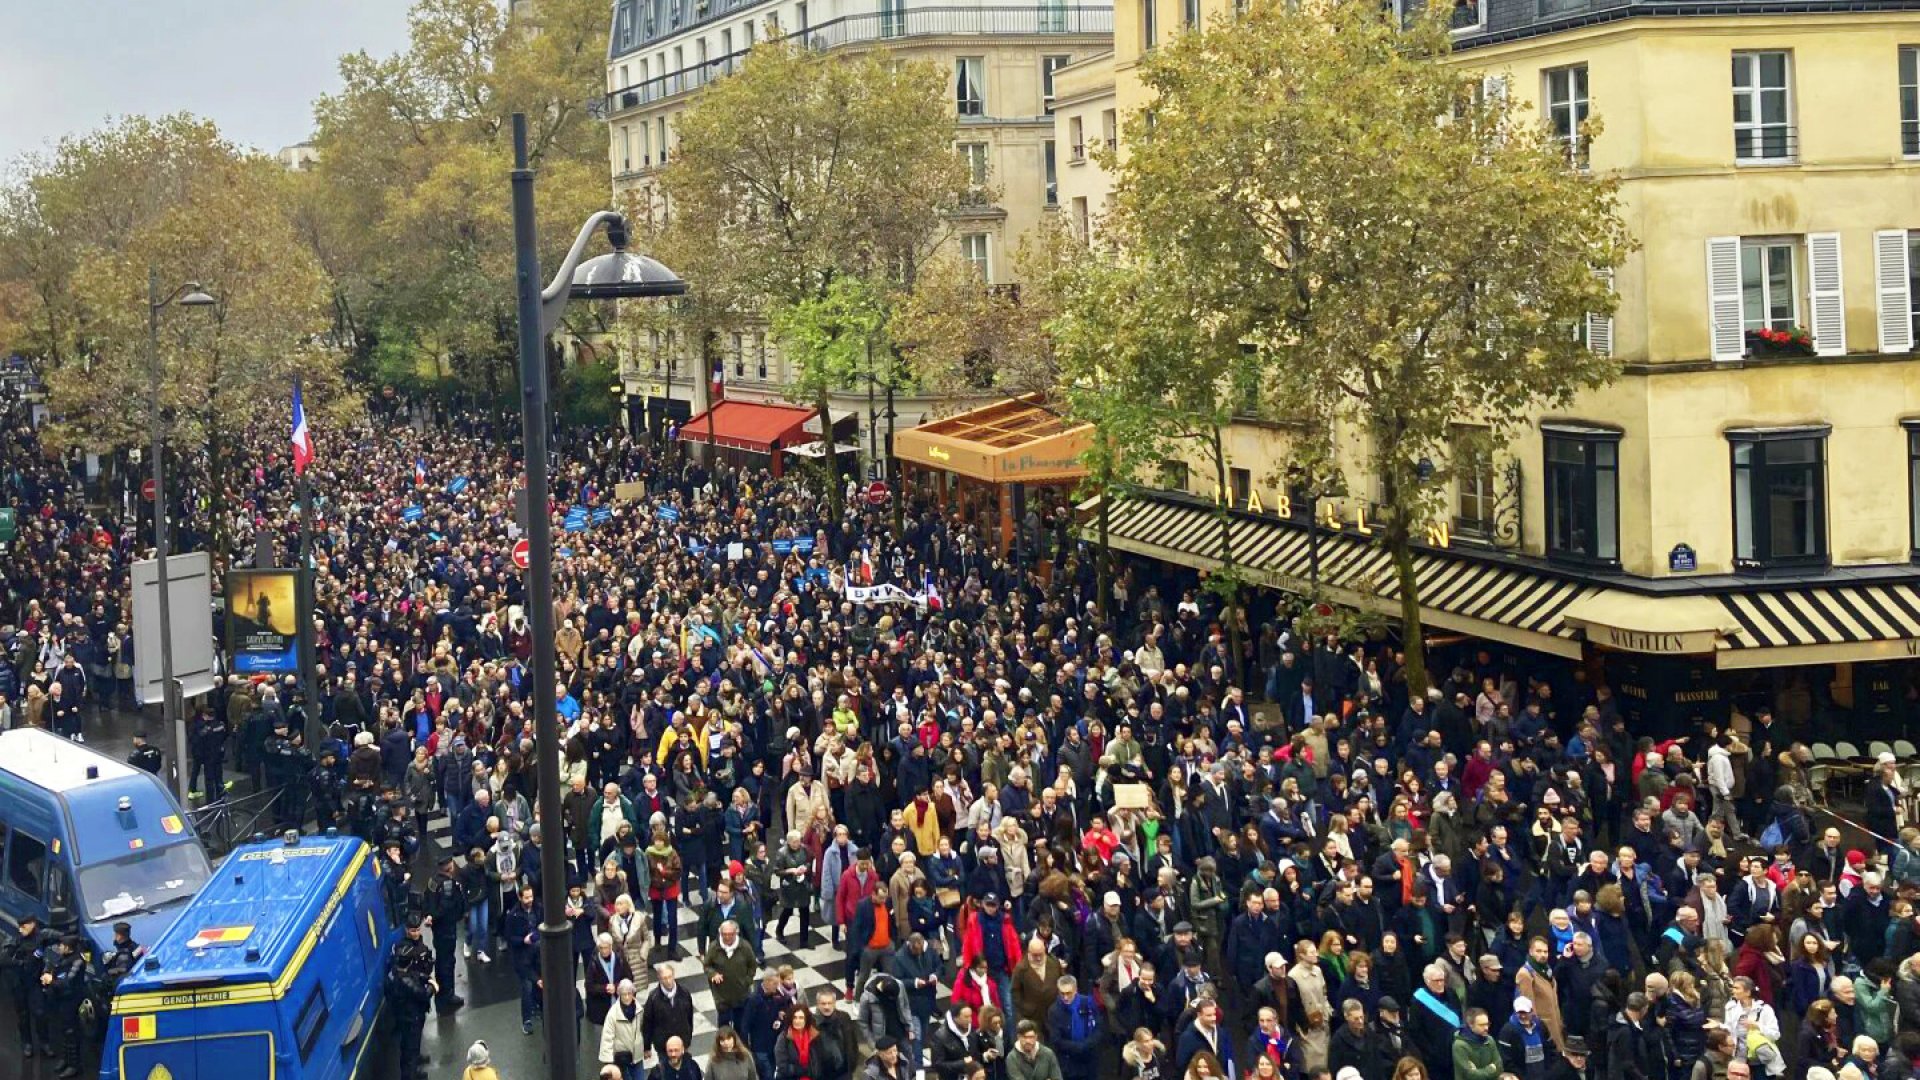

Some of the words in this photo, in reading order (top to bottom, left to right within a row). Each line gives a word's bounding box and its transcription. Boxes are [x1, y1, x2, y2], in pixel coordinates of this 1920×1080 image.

[1214, 483, 1449, 548] MABLLN
[1610, 626, 1682, 651] MABILLON
[163, 991, 229, 1005] GENDARMERIE
